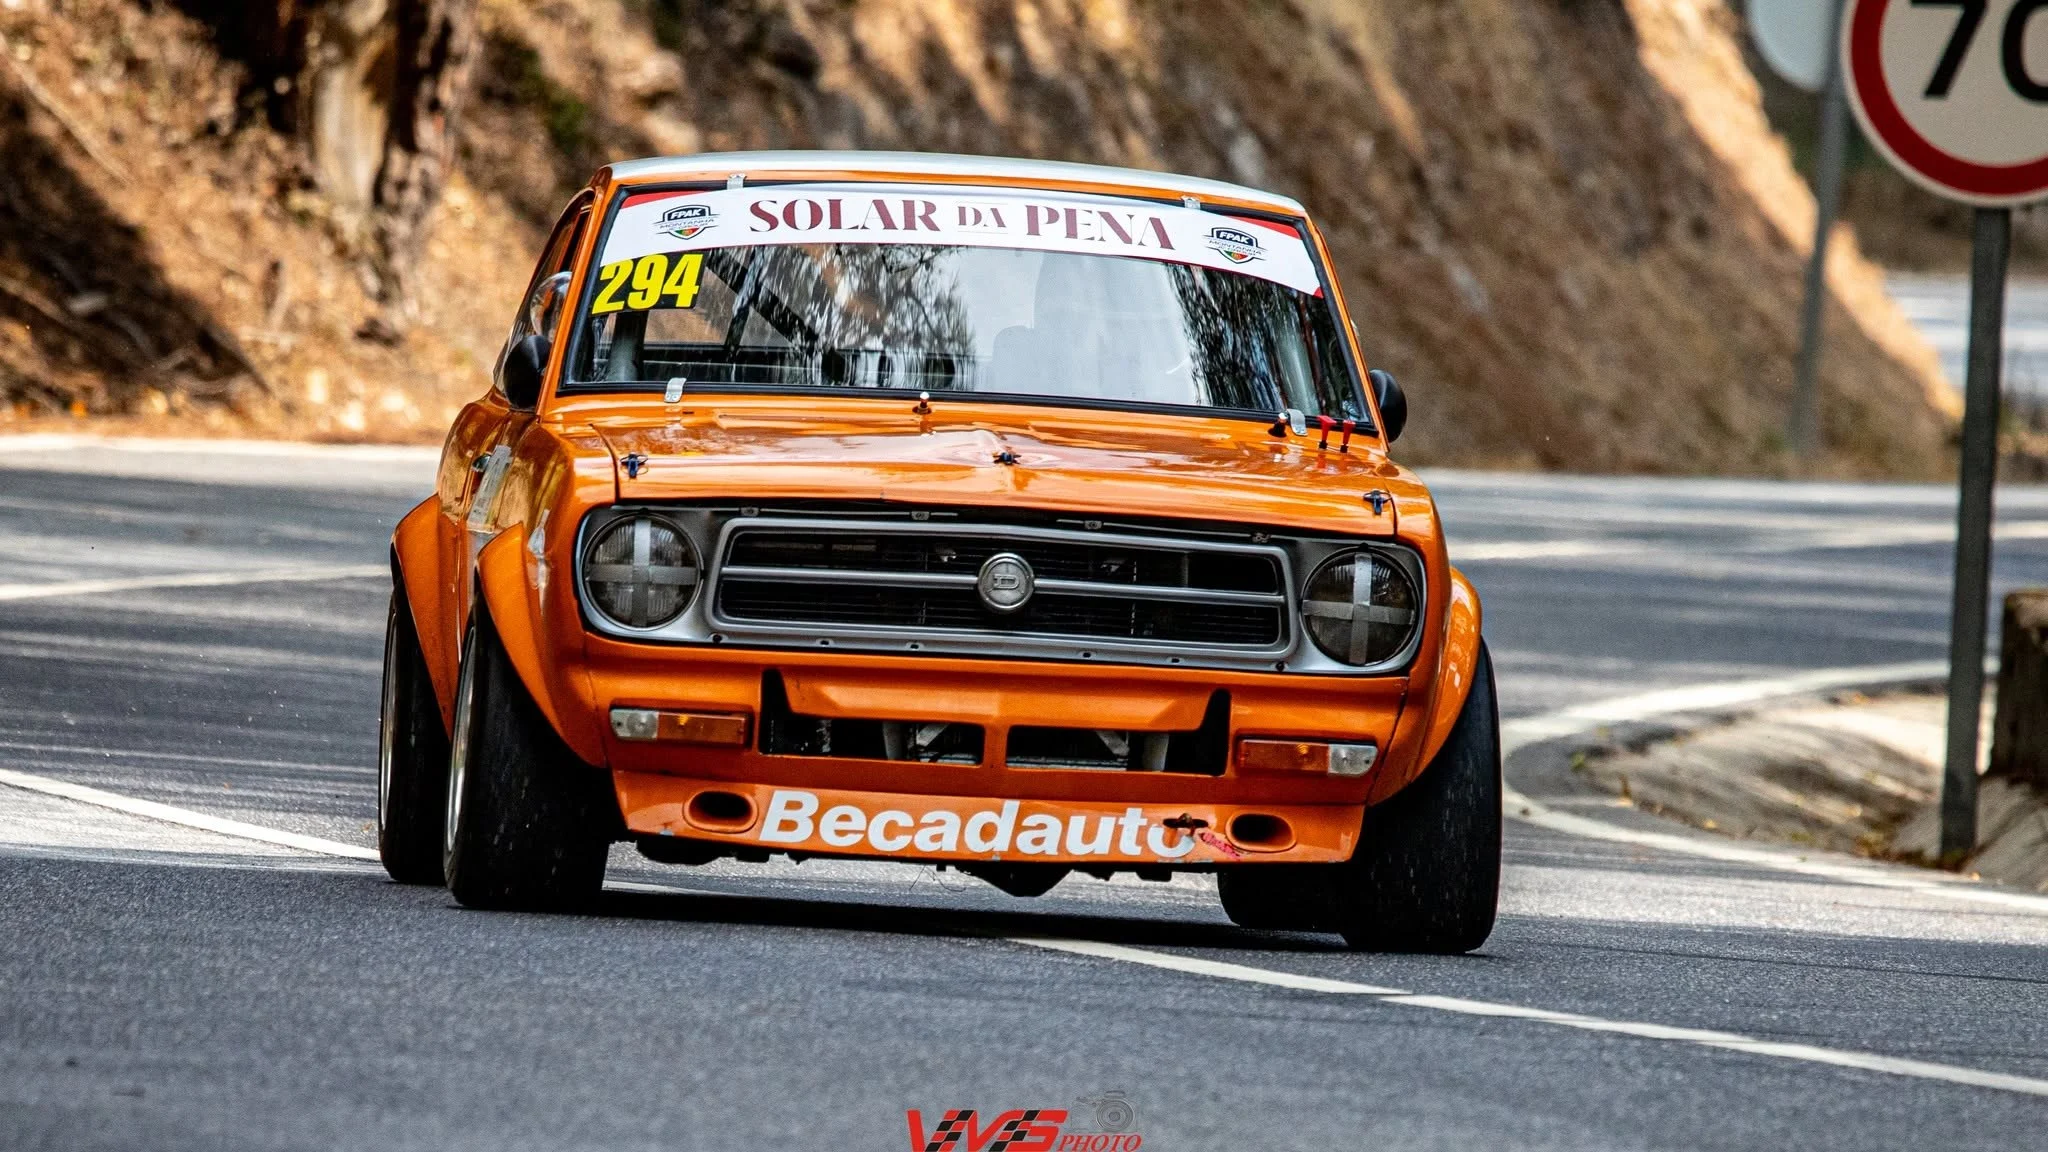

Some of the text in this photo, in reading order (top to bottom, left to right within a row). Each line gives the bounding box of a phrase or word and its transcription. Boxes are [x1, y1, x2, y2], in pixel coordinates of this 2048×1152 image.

[669, 208, 703, 220] FPAK
[749, 198, 1176, 251] SOLAR DA PENA
[1219, 231, 1250, 244] FPAK
[591, 253, 703, 315] 294
[758, 789, 1197, 858] Becadauto
